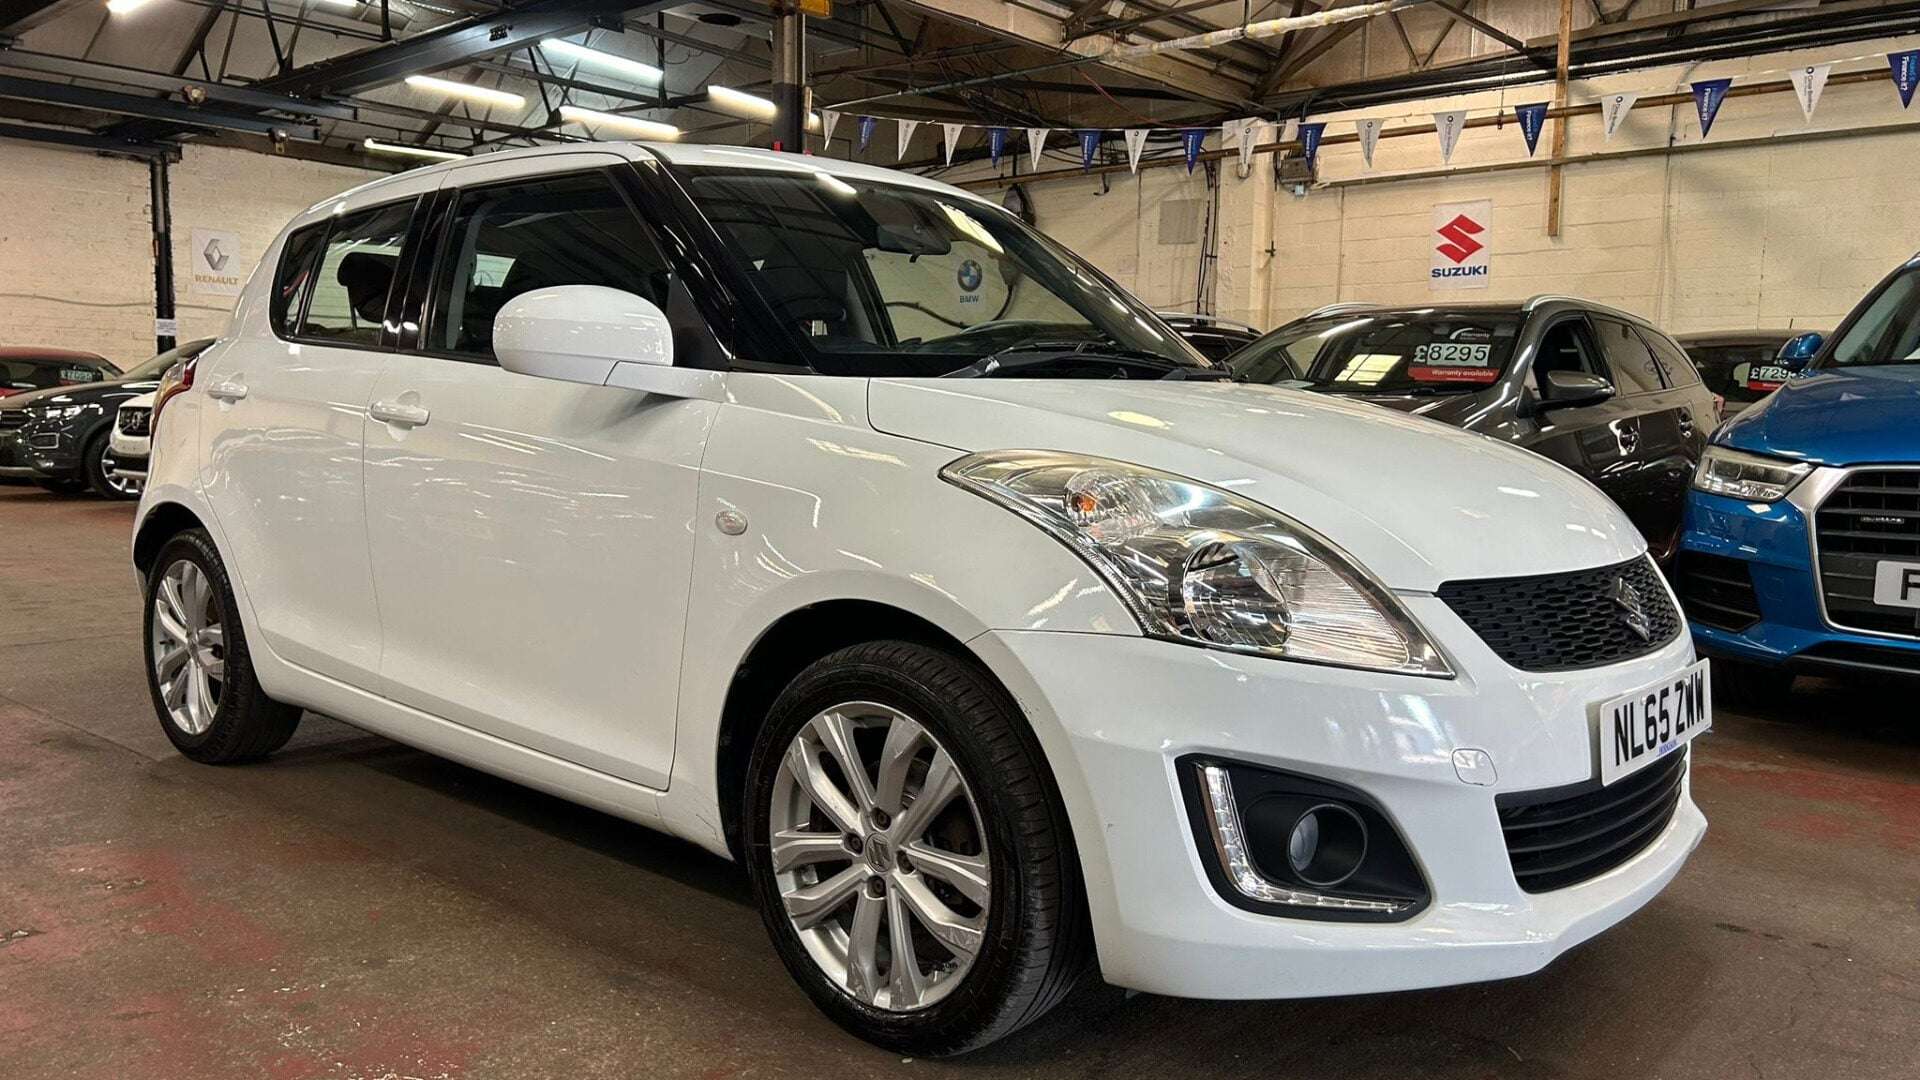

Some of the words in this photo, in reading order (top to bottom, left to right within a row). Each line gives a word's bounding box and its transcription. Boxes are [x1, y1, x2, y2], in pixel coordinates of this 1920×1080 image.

[1900, 55, 1910, 81] Finance
[1702, 87, 1711, 112] Finance
[1525, 110, 1533, 132] Finance
[194, 274, 239, 285] RENAULT
[1431, 265, 1488, 278] SUZUKI
[959, 295, 979, 304] BMW
[1413, 344, 1488, 363] £8295
[1614, 686, 1670, 767] NL65
[1674, 668, 1705, 736] ZWW
